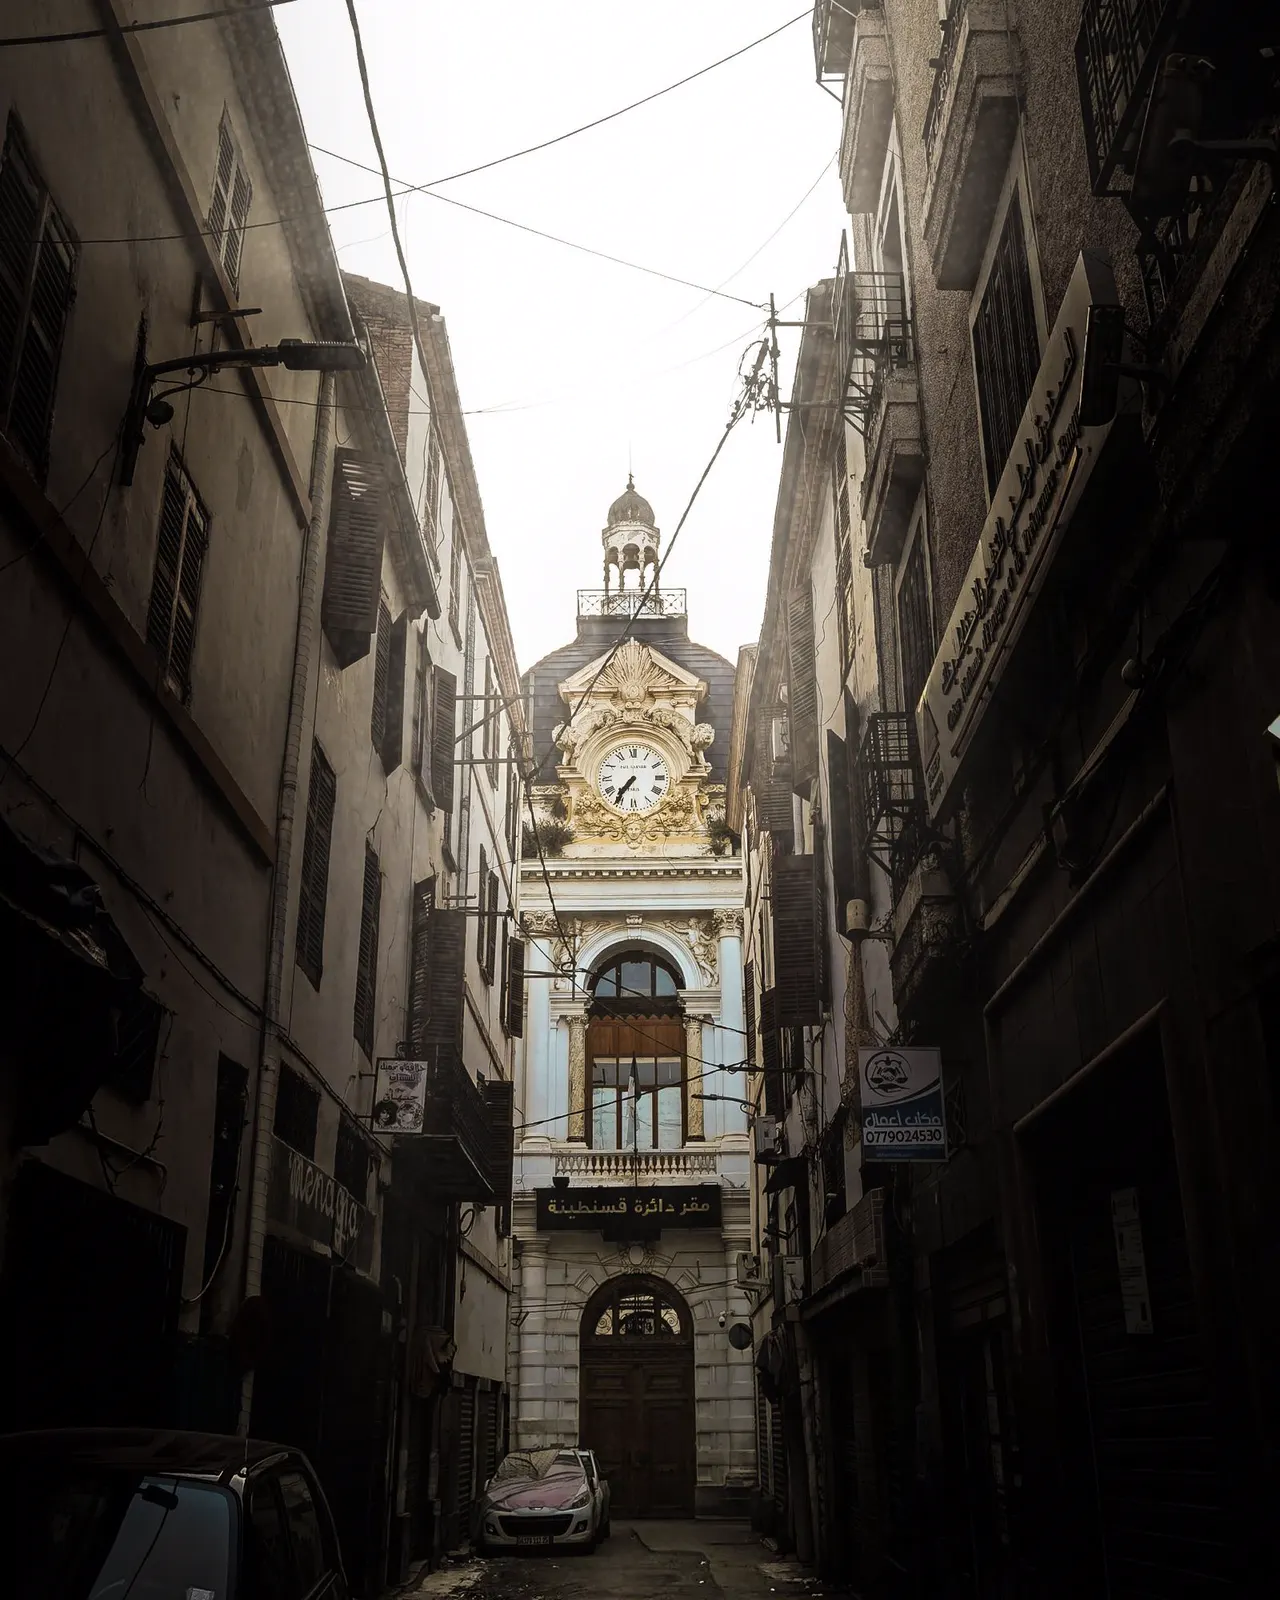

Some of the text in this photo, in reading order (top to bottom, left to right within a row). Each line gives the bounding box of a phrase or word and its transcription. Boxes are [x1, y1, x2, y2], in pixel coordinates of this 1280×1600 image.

[865, 1129, 942, 1143] 0779024530
[547, 1196, 710, 1219] مقر دائرة قسنطينة
